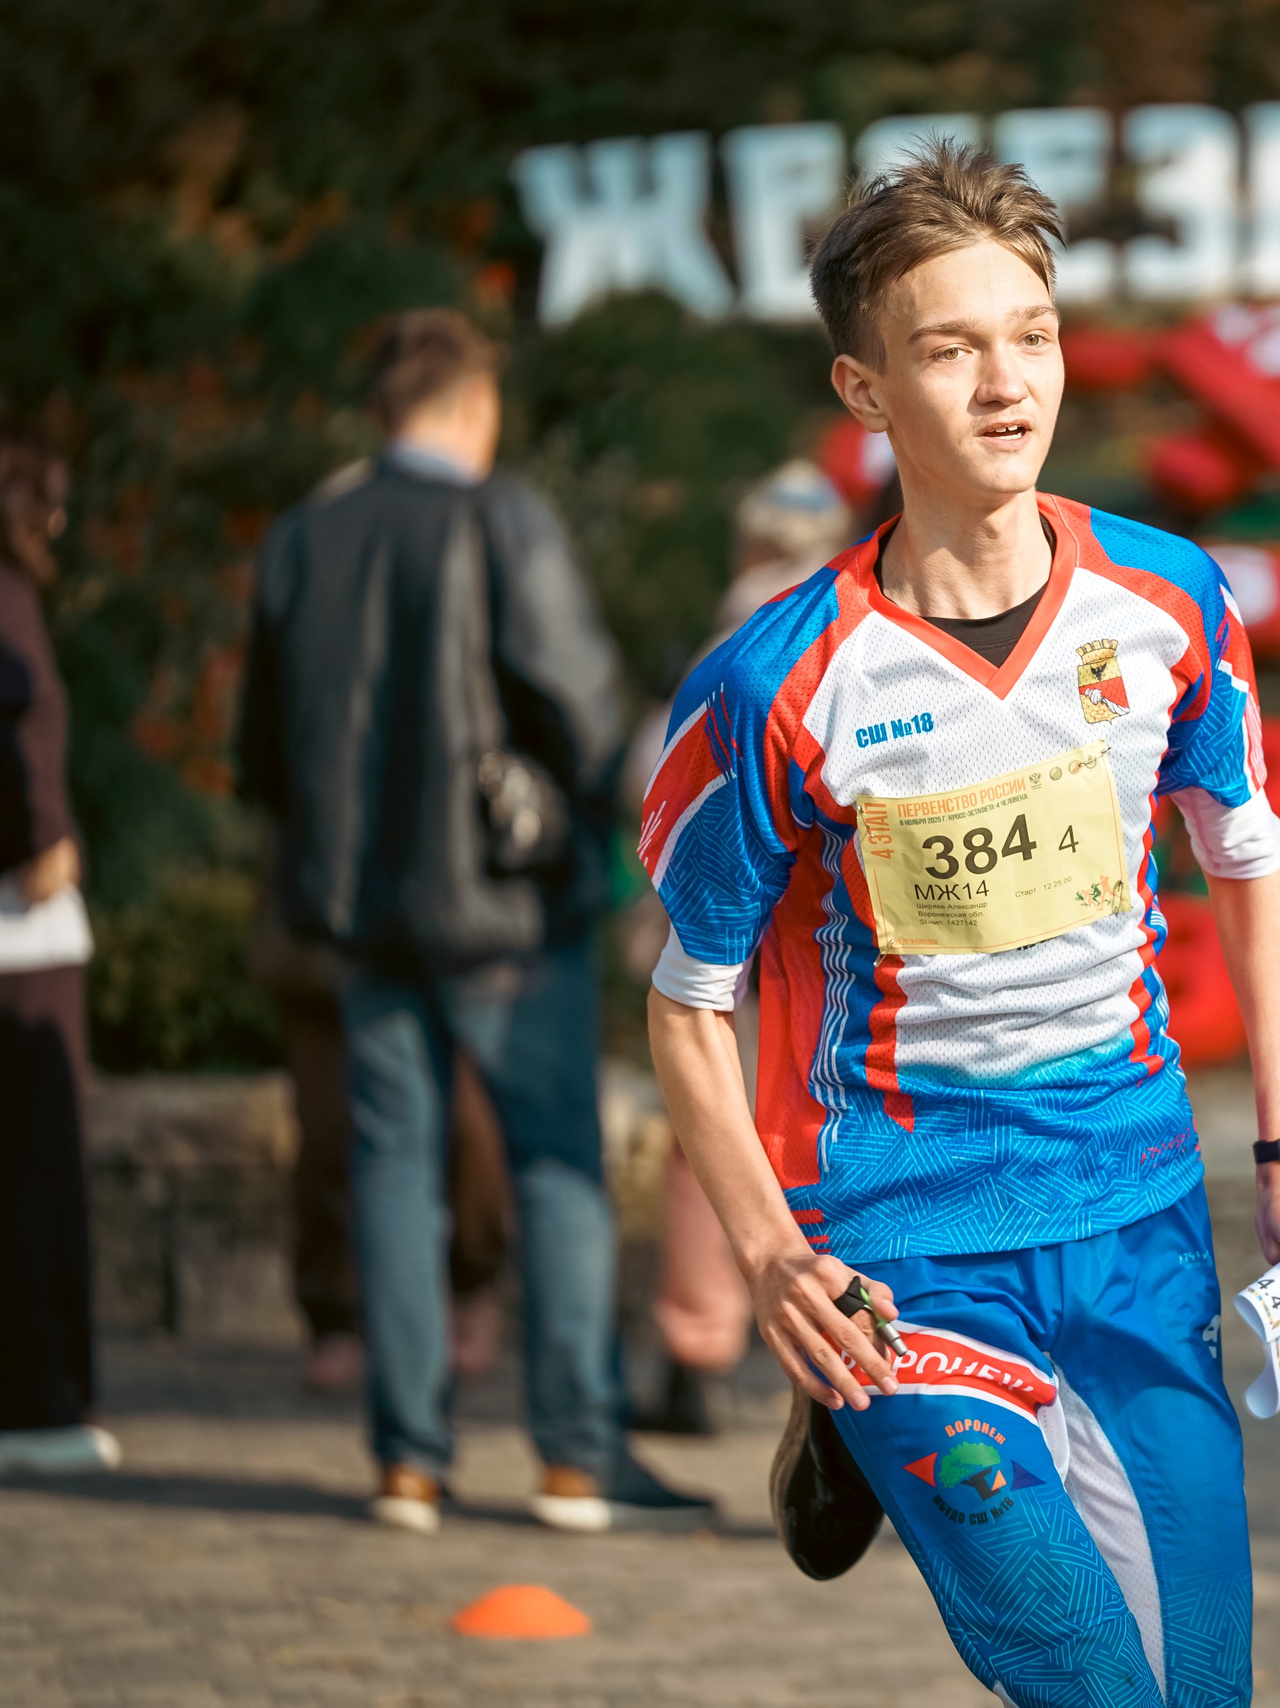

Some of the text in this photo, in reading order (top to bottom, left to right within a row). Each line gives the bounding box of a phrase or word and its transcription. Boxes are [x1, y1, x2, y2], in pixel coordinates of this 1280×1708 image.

[855, 712, 934, 748] СШ №18
[897, 777, 1026, 818] ПЕРВЕНСТВО РОССИИ
[904, 817, 927, 826] НОЯБРЯ
[927, 815, 942, 824] 2025
[1000, 793, 1028, 806] ЧЕЛОВЕКА
[864, 802, 895, 860] 4 ЭТАП
[922, 813, 1079, 880] 384 4
[914, 879, 990, 901] МЖ14
[1014, 888, 1037, 898] Старт
[916, 902, 988, 910] Ширяев Александр
[944, 1418, 1007, 1446] ВОРОНЕЖ
[969, 1511, 989, 1525] СШ
[989, 1496, 1015, 1520] №18
